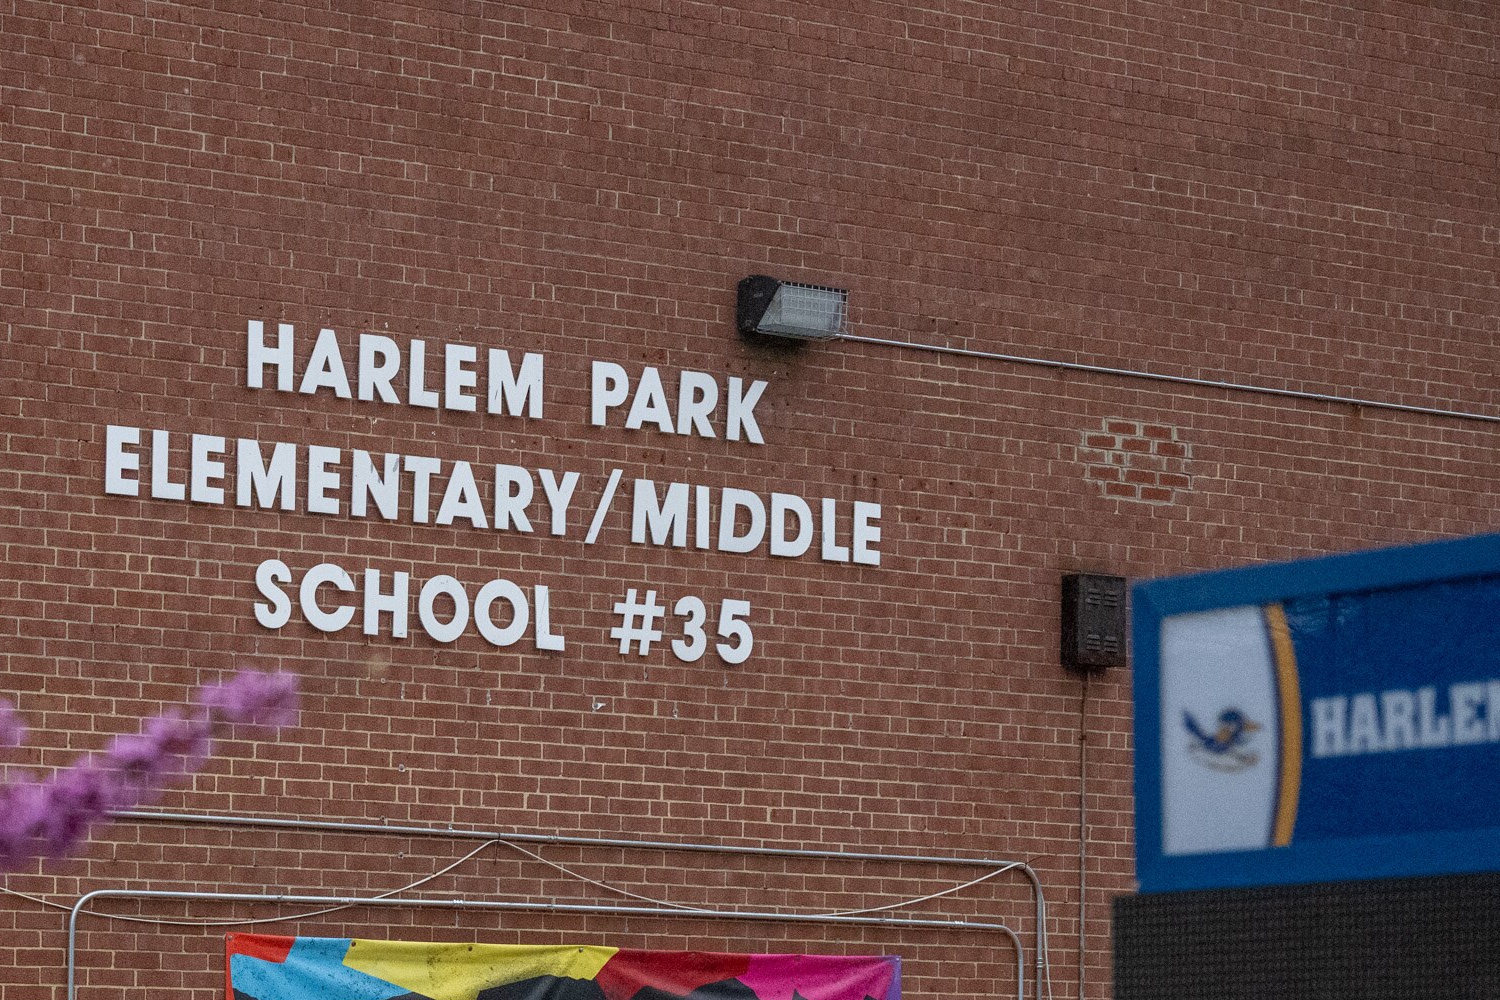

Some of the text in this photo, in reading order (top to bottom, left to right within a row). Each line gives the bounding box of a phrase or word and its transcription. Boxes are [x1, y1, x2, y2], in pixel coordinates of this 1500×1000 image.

[248, 320, 767, 444] HARLEM PARK
[106, 425, 881, 565] ELEMENTARY/MIDDLE
[254, 559, 753, 663] SCHOOL #35
